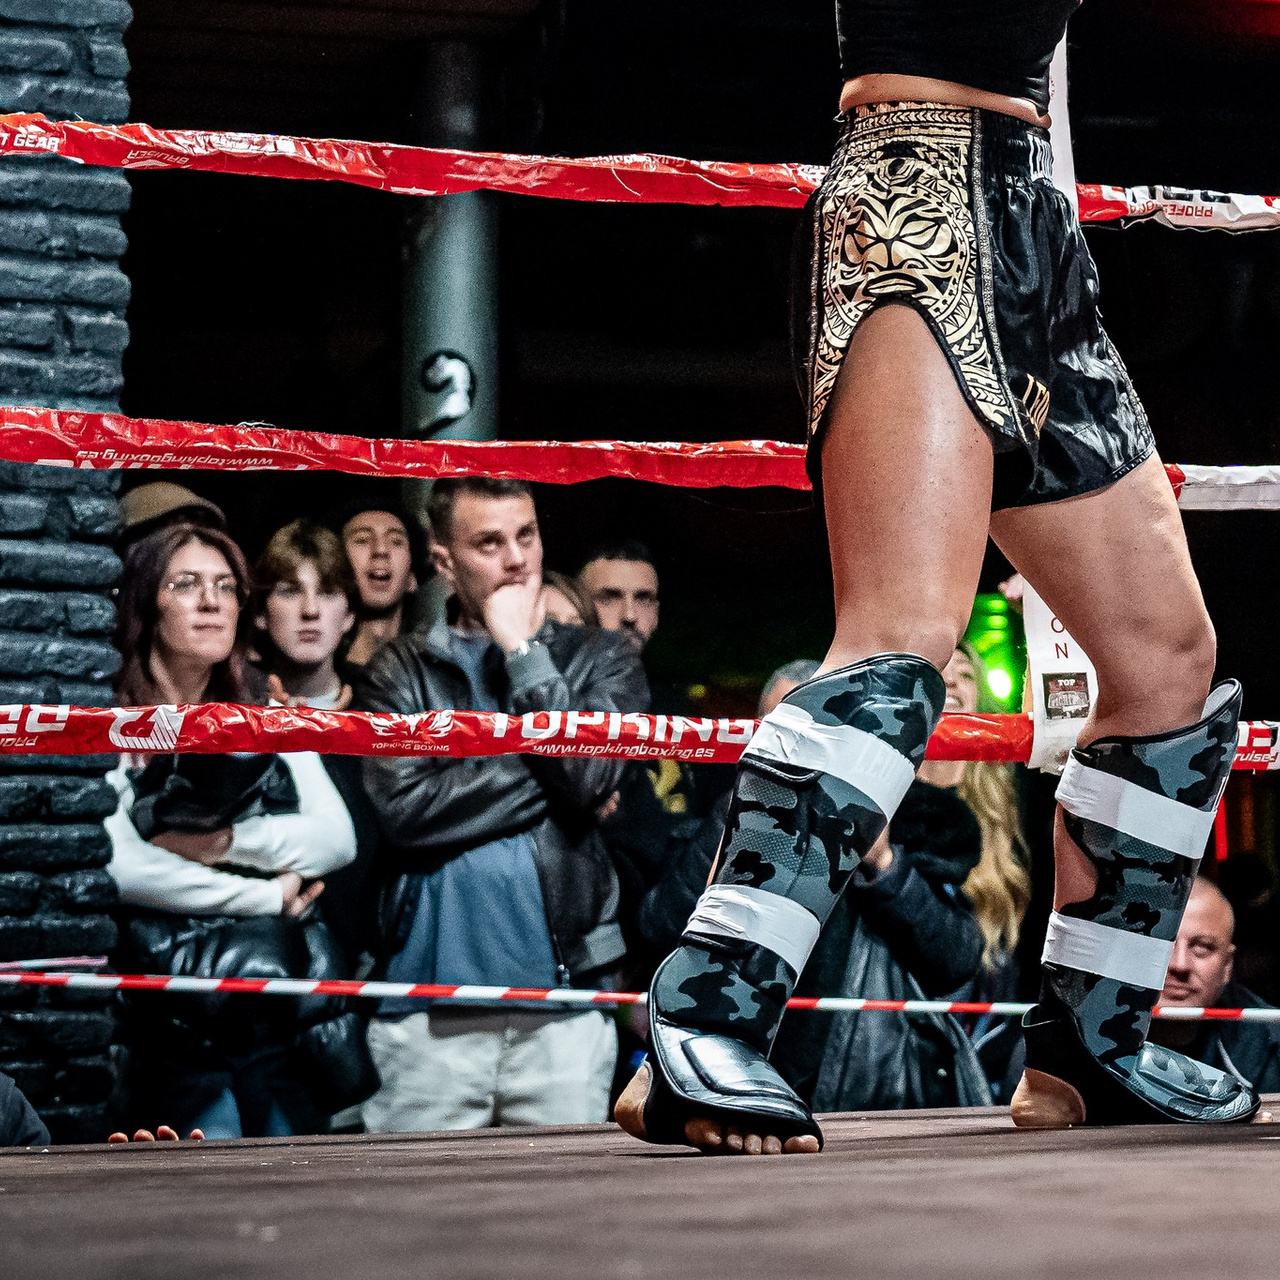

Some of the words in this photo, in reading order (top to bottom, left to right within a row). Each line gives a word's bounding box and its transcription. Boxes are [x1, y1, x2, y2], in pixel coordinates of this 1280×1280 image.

[13, 134, 60, 152] GEAR
[1058, 679, 1076, 687] TOP
[371, 742, 411, 752] TOPKING
[413, 743, 450, 753] BOXING
[532, 742, 715, 759] www.topkingboxing.es
